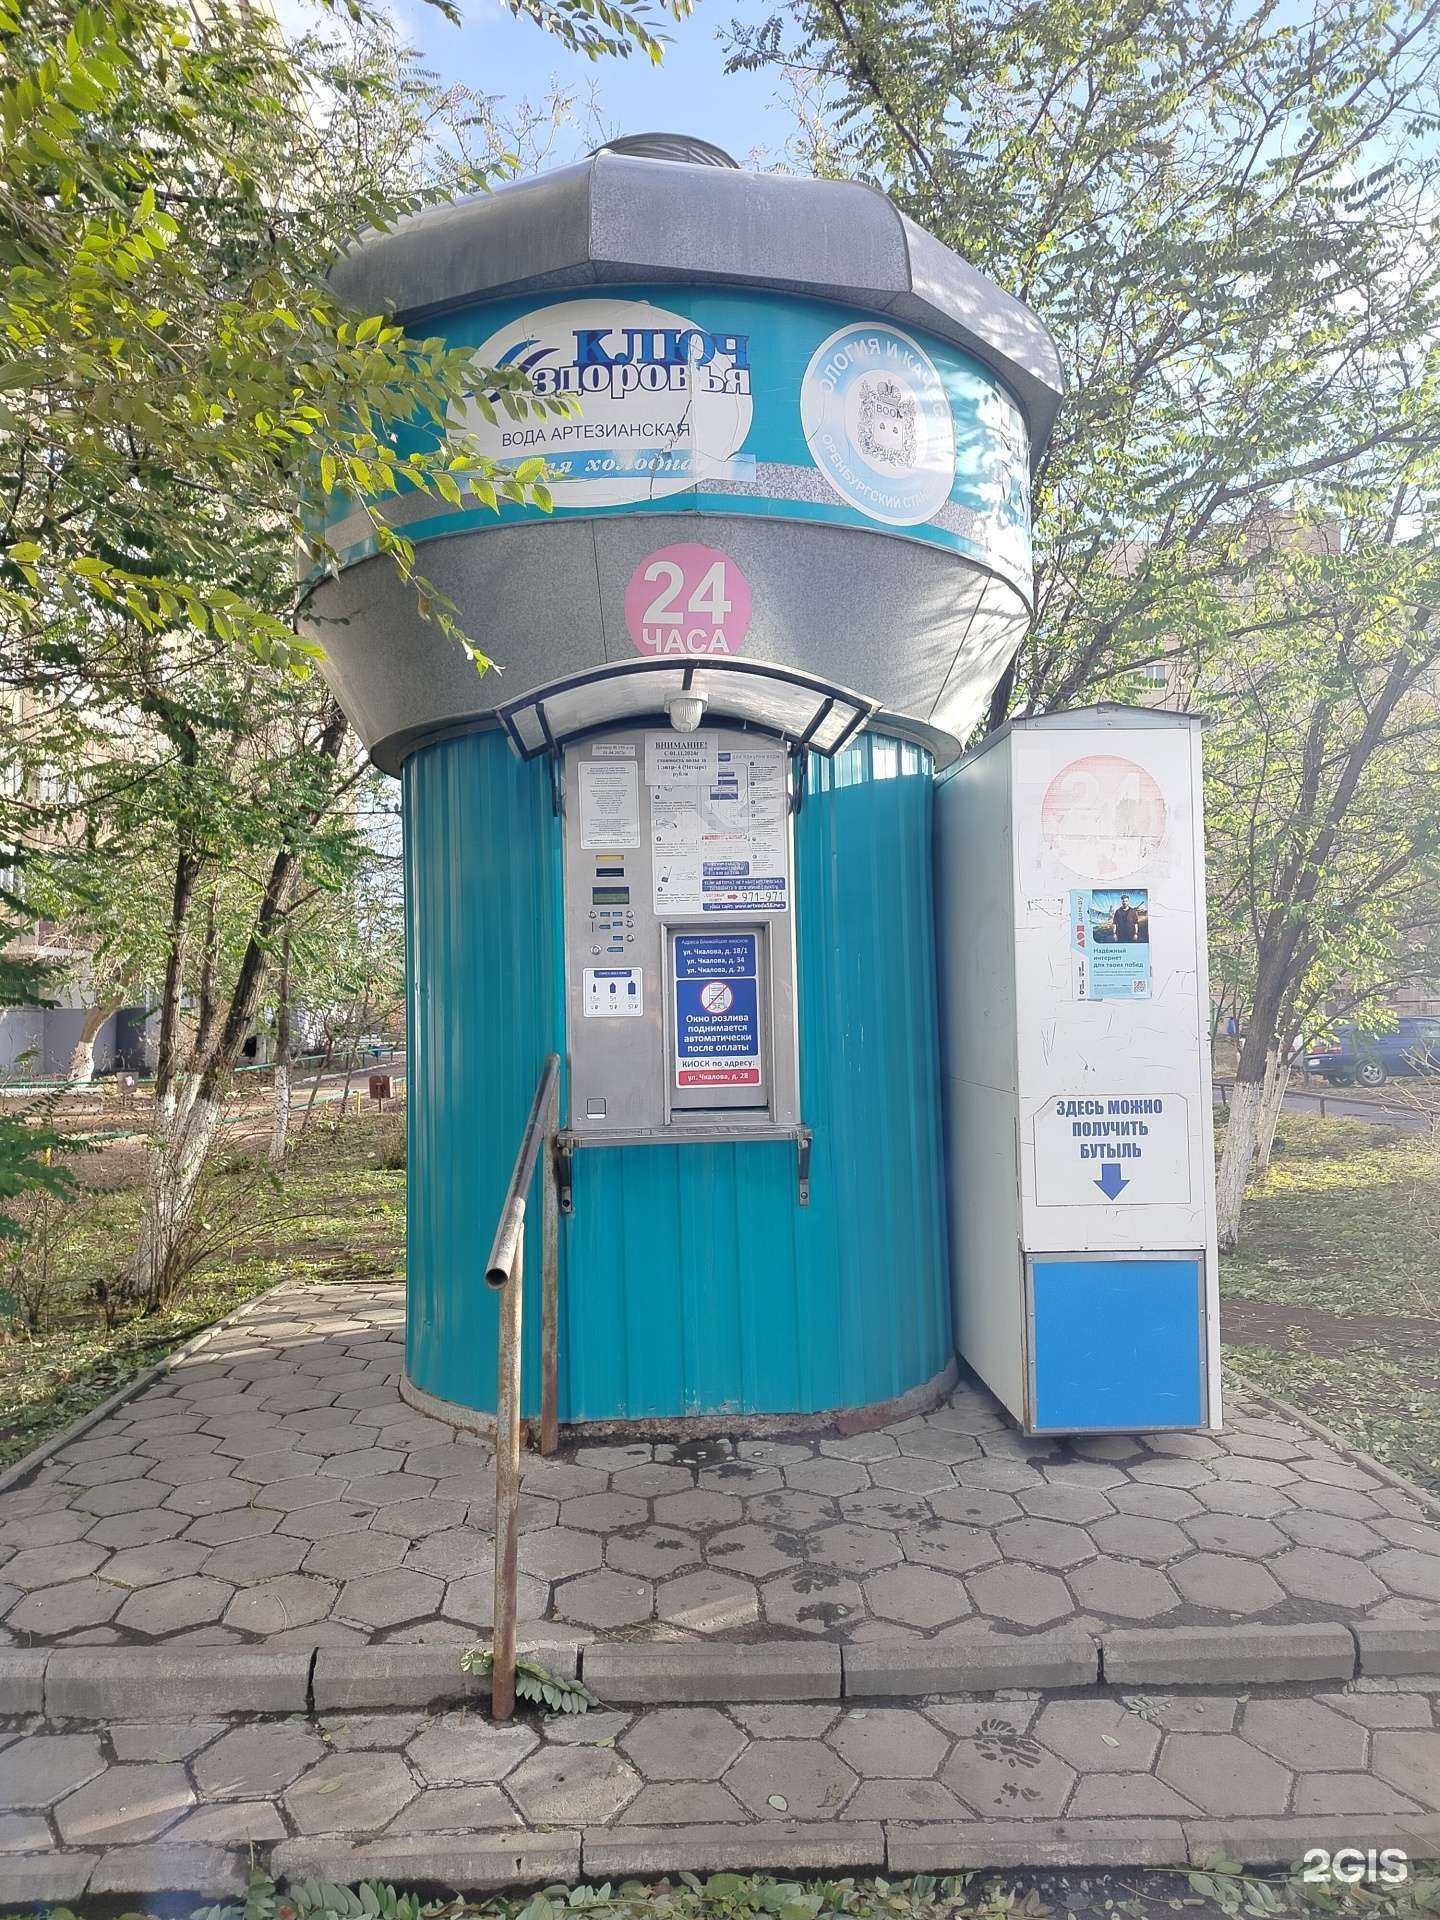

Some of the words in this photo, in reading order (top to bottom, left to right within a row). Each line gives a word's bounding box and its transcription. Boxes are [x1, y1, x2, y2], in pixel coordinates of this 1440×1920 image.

[572, 328, 750, 369] КЛЮЧ
[532, 363, 752, 399] здоровья
[502, 428, 546, 447] ВОДА
[551, 422, 691, 442] АРТЕЗИАНСКАЯ
[643, 560, 732, 625] 24
[642, 628, 731, 654] ЧАСА
[655, 741, 708, 750] ВНИМАНИЕ!
[741, 891, 784, 902] 971-971
[685, 1014, 710, 1023] Окно
[711, 1014, 749, 1024] розлива
[687, 1024, 748, 1034] поднимается
[684, 1034, 752, 1043] автоматически
[687, 1045, 713, 1053] после
[715, 1044, 749, 1052] оплаты
[682, 1060, 710, 1068] КИОСК
[724, 1060, 755, 1068] адресу:
[1056, 1100, 1104, 1118] ЗДЕСЬ
[1107, 1098, 1164, 1115] МОЖНО
[1071, 1121, 1149, 1137] ПОЛУЧИТЬ
[1080, 1143, 1142, 1159] БУТЫЛЬ
